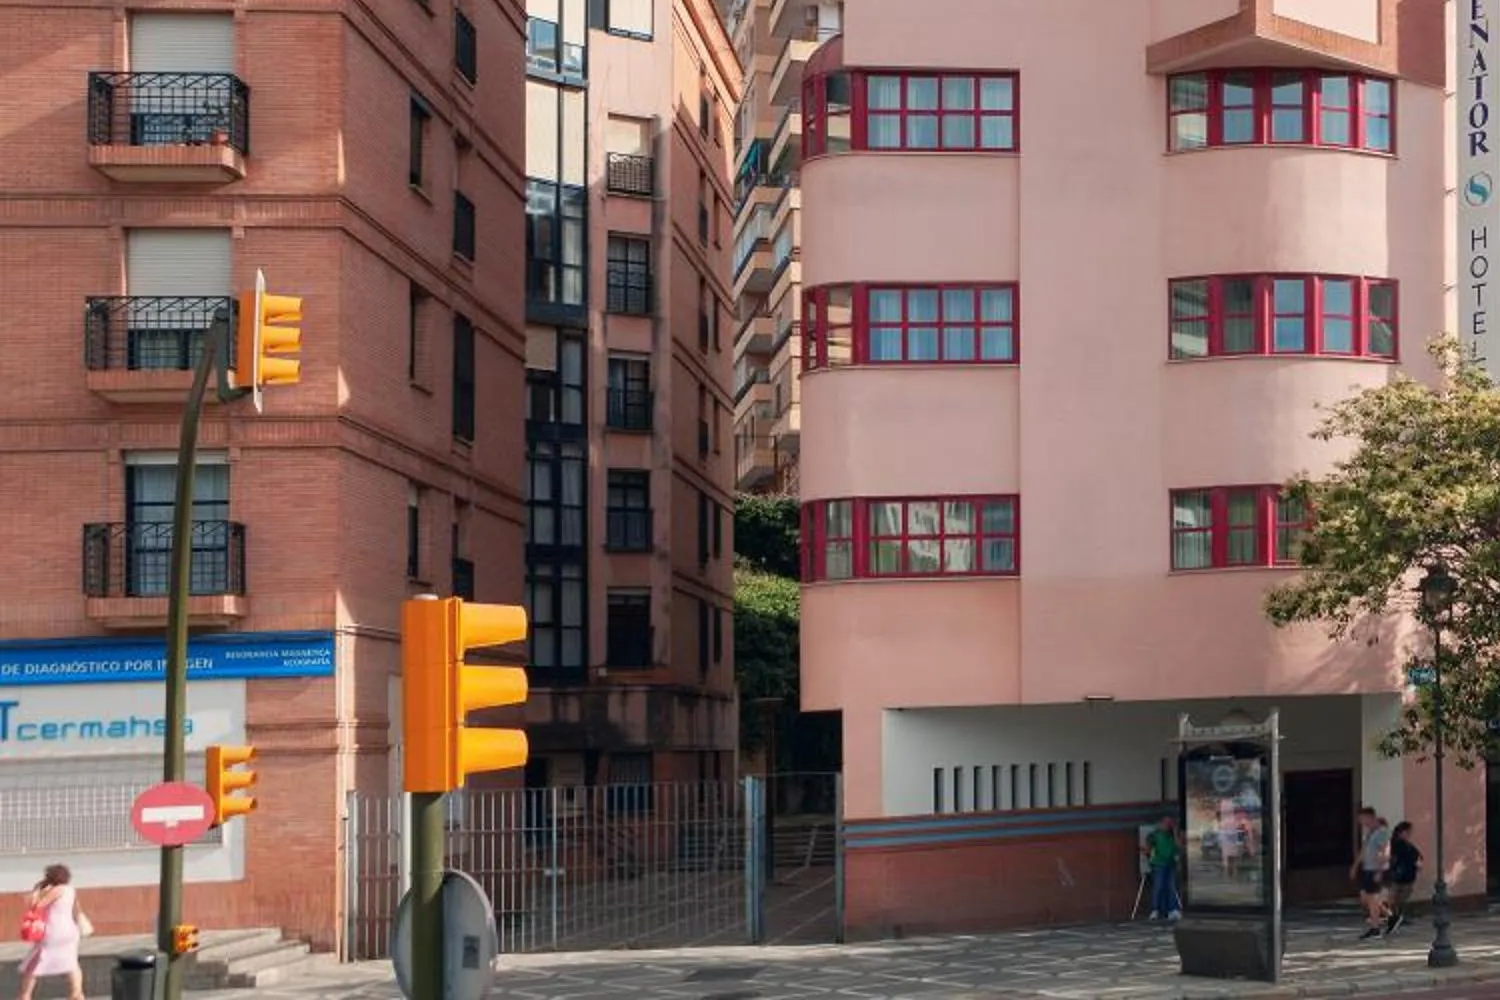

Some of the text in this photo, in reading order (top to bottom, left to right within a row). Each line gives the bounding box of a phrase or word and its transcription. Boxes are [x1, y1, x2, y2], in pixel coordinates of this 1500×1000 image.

[1469, 225, 1489, 363] HOTEL
[1, 657, 213, 676] DE DIAGNÓSTICO POR IGEN
